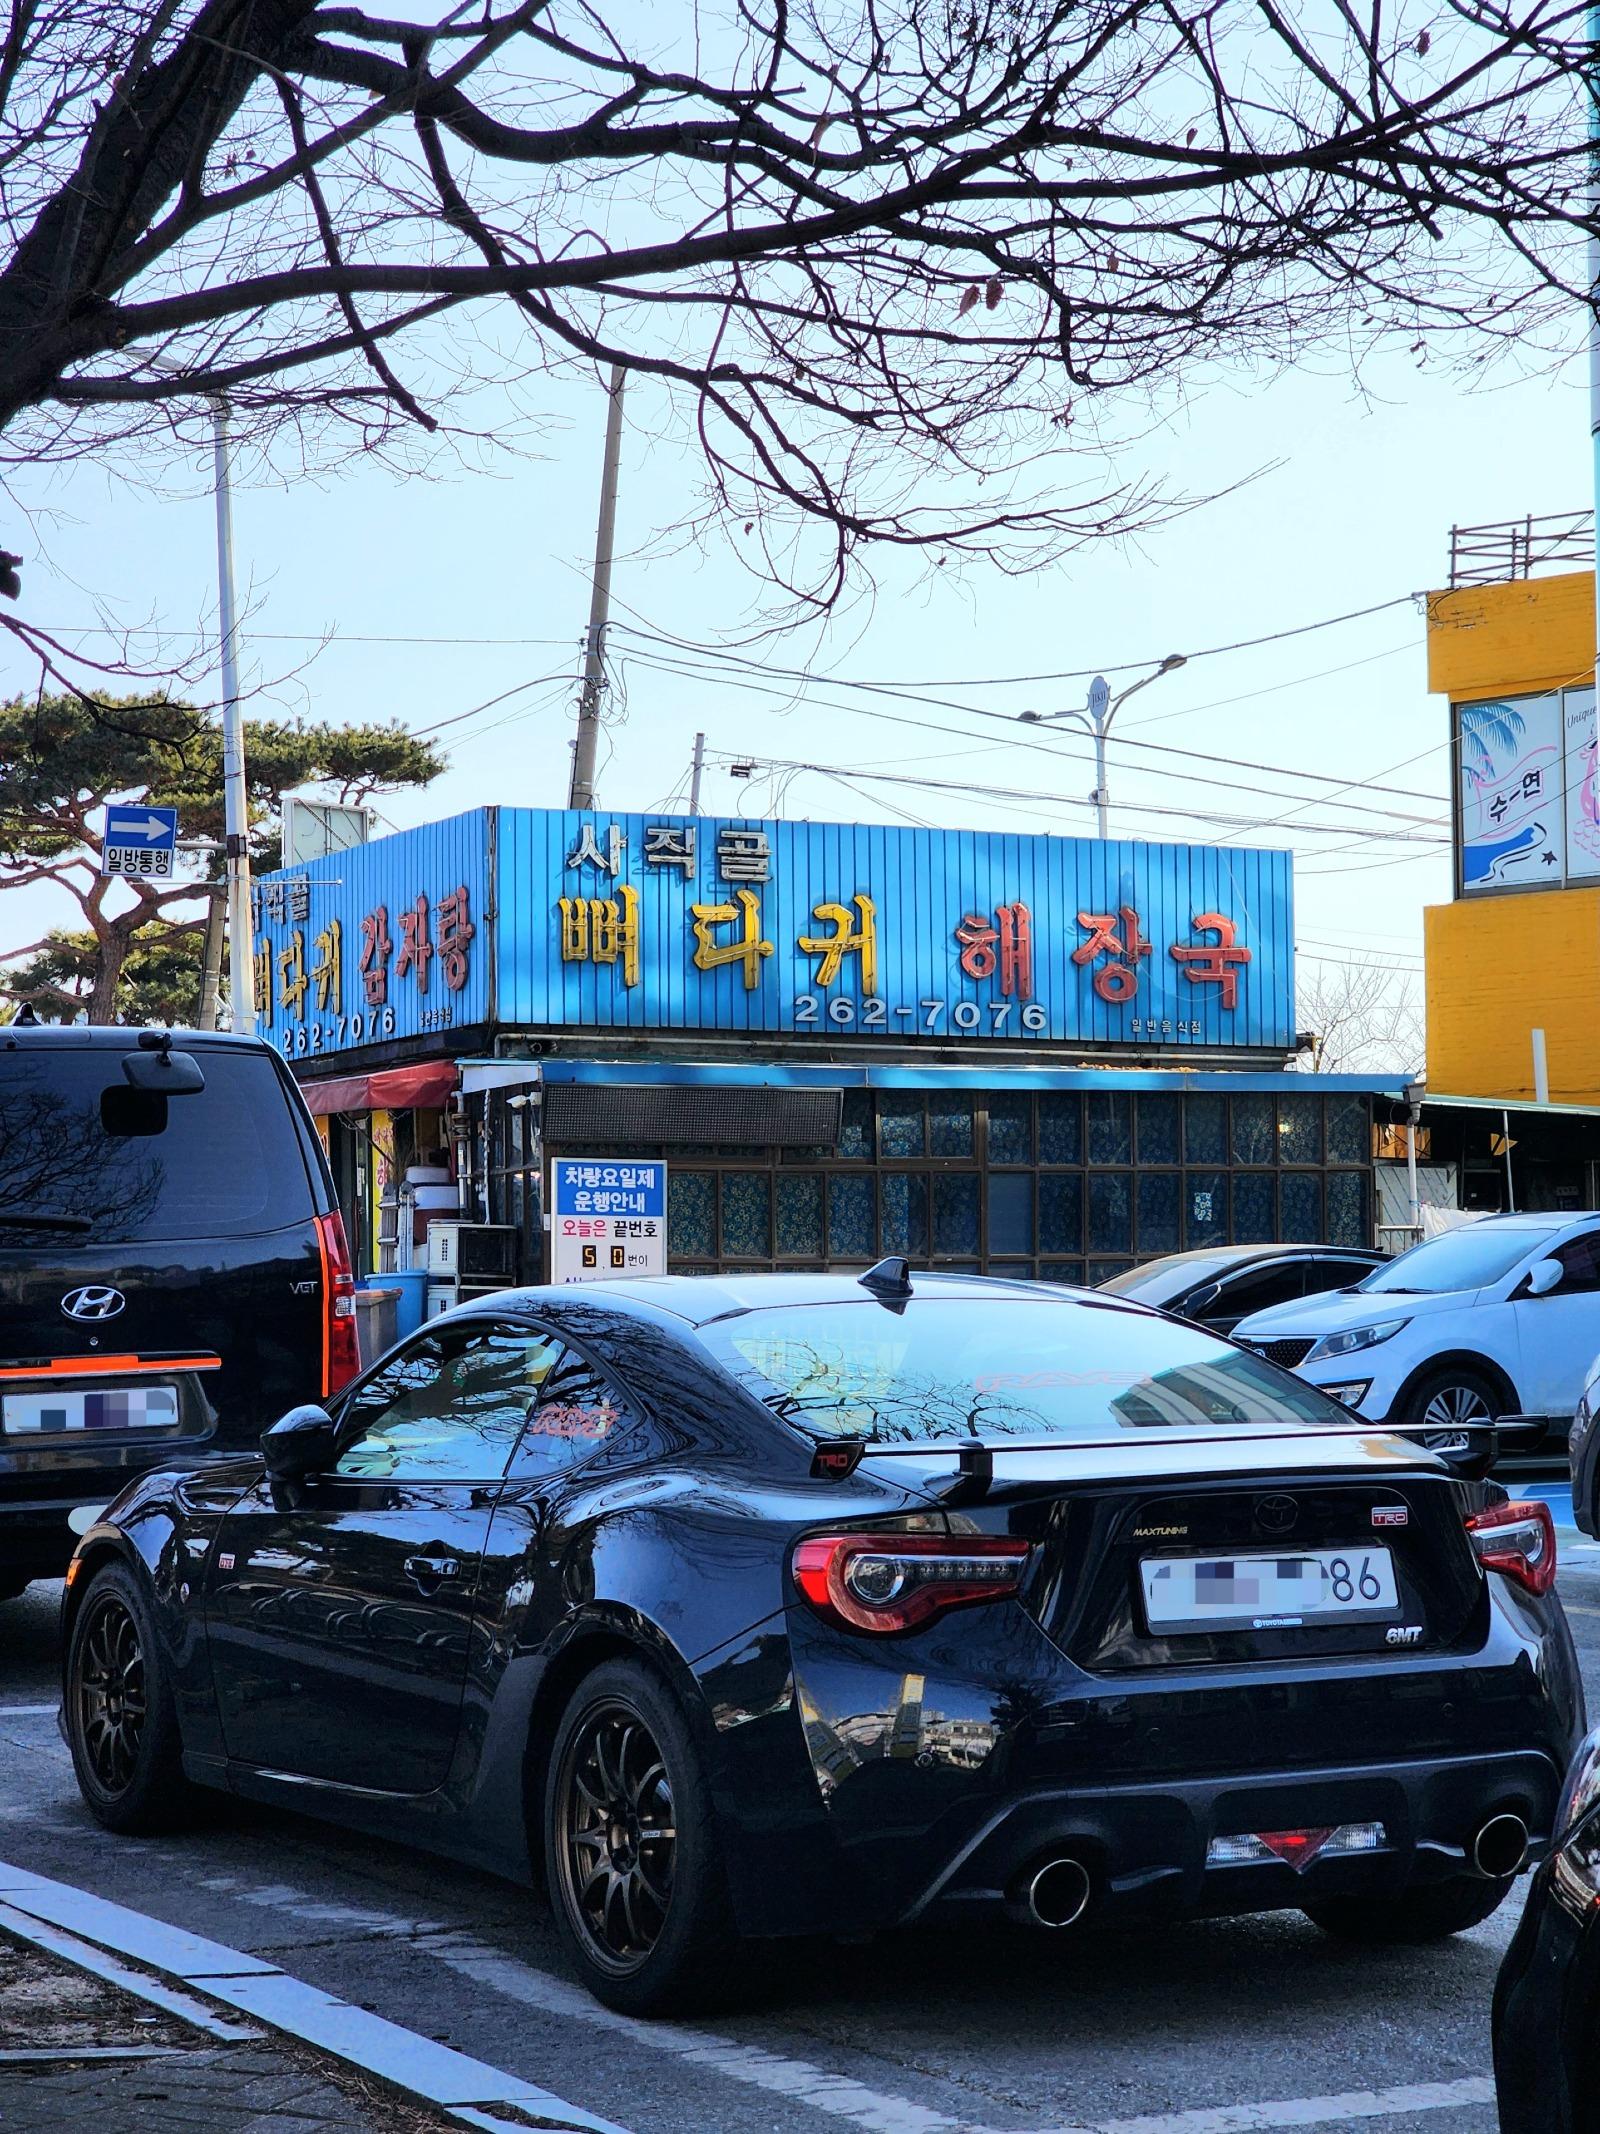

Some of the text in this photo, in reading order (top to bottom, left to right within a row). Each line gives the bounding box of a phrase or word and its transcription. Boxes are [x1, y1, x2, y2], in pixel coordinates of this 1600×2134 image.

[108, 848, 168, 875] 일방통행
[568, 823, 774, 882] 사직골
[358, 884, 475, 1007] 감자탕
[558, 884, 1253, 1010] 뼈다귀 해장국
[794, 995, 1047, 1030] 262-7076
[282, 1007, 396, 1053] 262-7076
[1131, 1018, 1201, 1034] 일반음식점
[565, 1166, 655, 1189] 차량요일제
[574, 1190, 645, 1213] 운행안내
[562, 1219, 658, 1238] 오늘은 끝번호
[612, 1247, 624, 1266] 0
[628, 1254, 648, 1267] 번이
[289, 1281, 318, 1295] VGT
[817, 1454, 848, 1467] TRD
[1373, 1513, 1406, 1525] TRD
[1385, 1626, 1423, 1644] 6MT
